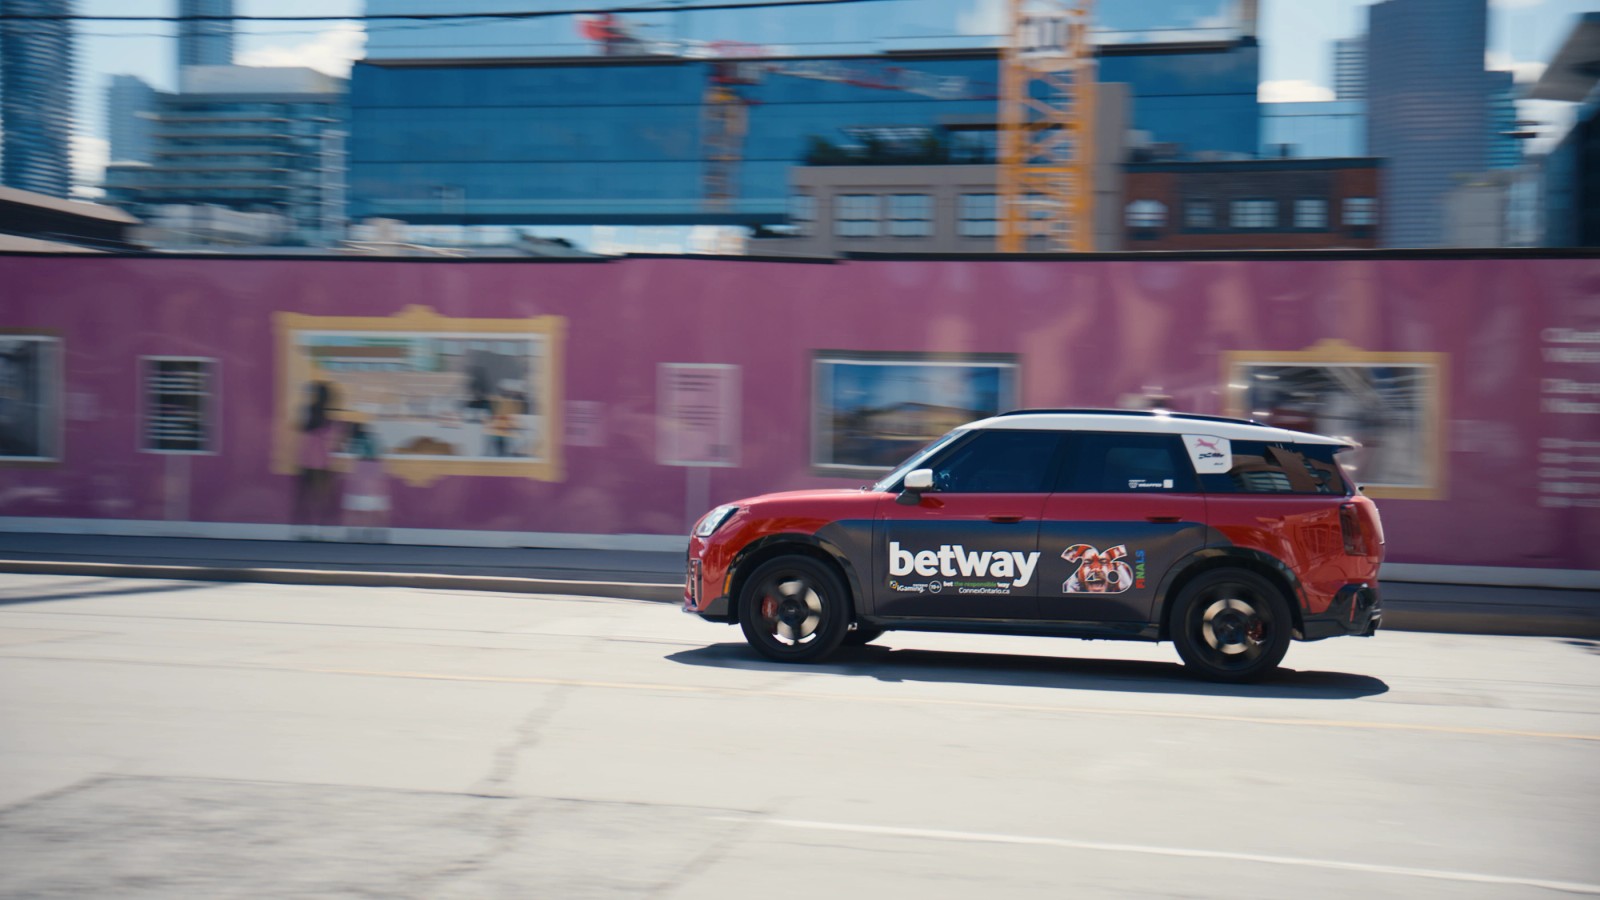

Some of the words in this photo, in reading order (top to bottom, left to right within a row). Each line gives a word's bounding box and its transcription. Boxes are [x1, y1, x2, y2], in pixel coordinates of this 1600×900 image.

[889, 542, 1041, 587] betway
[1060, 544, 1133, 594] 26
[1136, 549, 1145, 588] FINALS
